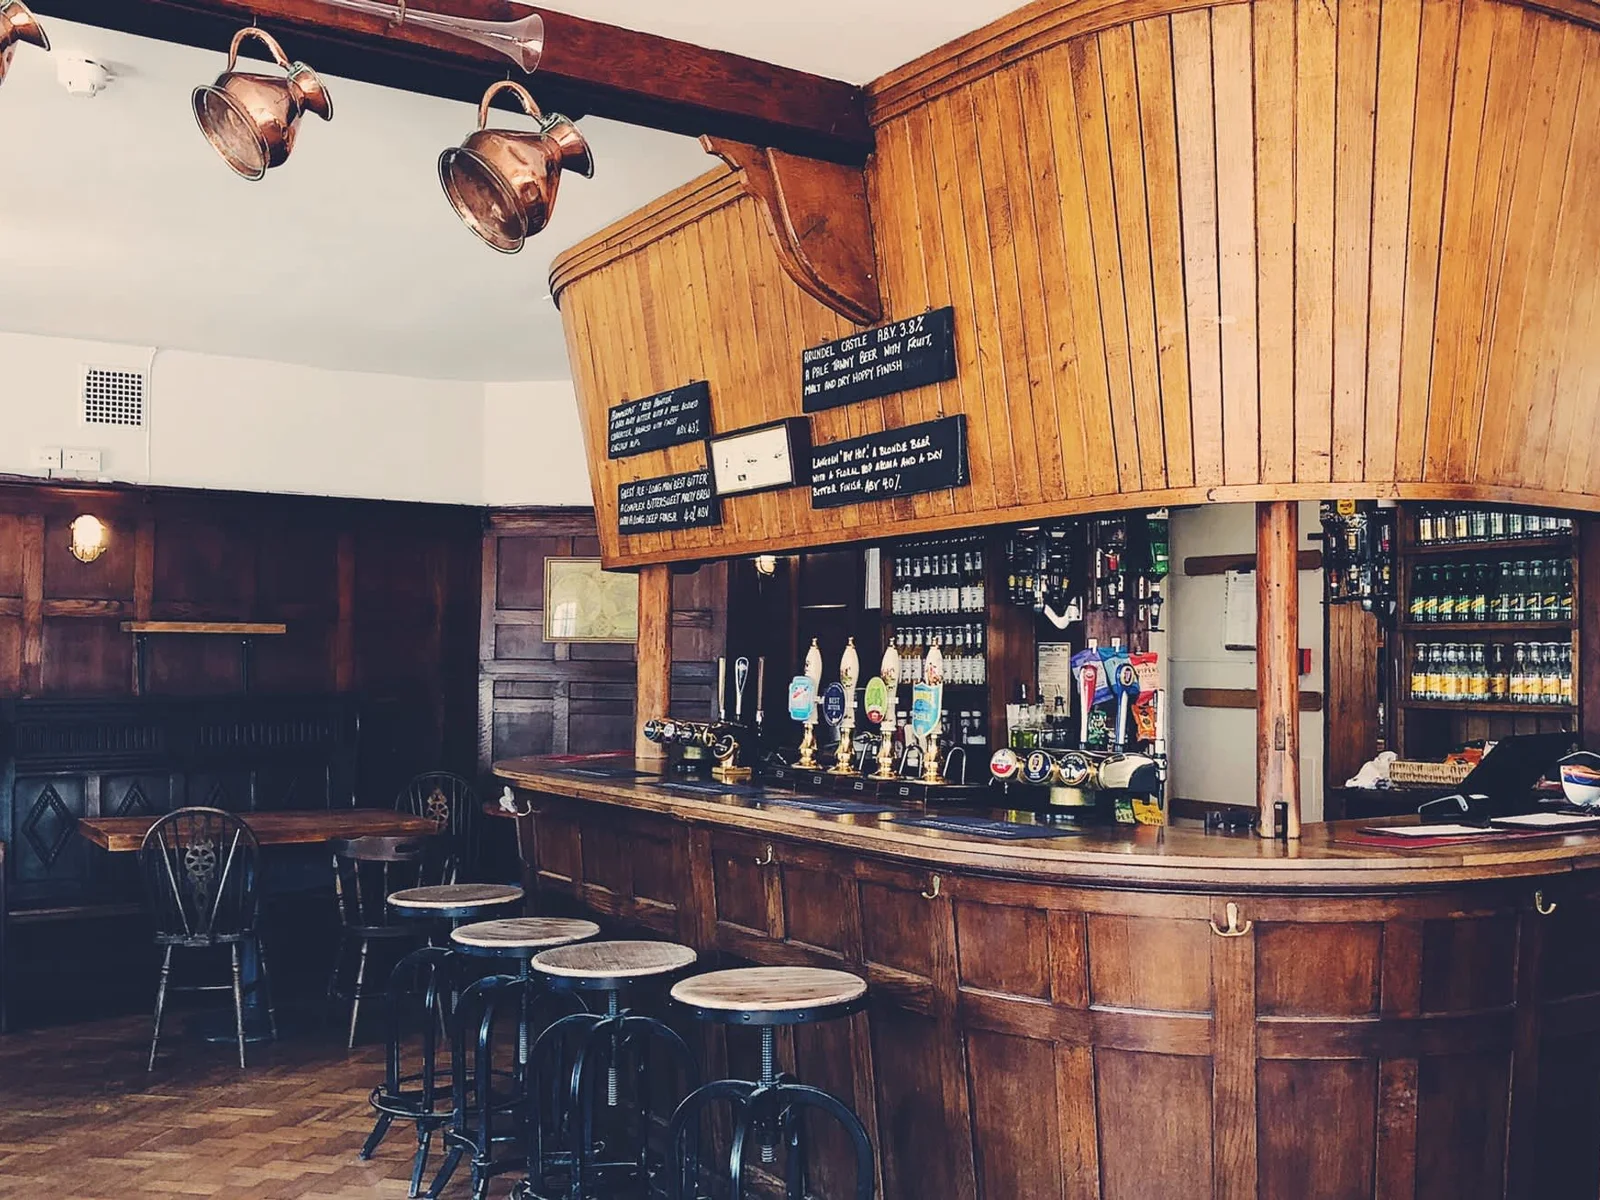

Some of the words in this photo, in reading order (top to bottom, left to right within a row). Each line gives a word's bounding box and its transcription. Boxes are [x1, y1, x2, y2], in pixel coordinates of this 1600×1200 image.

[841, 334, 867, 352] CASTLE
[900, 316, 924, 337] 3.8%
[812, 362, 829, 379] PALE
[860, 348, 878, 364] BEER
[884, 343, 901, 357] WITH
[804, 384, 820, 396] MALT
[824, 380, 836, 390] AND
[838, 374, 850, 388] DRY
[852, 366, 874, 384] HOPPY
[876, 360, 902, 377] FINISH
[880, 442, 907, 456] BLONDE
[910, 436, 930, 450] BEER
[812, 473, 825, 483] WITH
[836, 467, 860, 478] FLORAL
[861, 463, 873, 474] HOP
[875, 459, 898, 471] AROMA
[900, 455, 916, 468] AND
[928, 450, 943, 461] DRY
[648, 483, 662, 494] LONG
[813, 484, 836, 496] BITTER
[865, 479, 880, 493] ABV
[624, 502, 645, 512] COMPLEX
[646, 493, 680, 510] BITTERSWEET
[633, 515, 645, 525] LONG
[646, 513, 658, 524] DEEP
